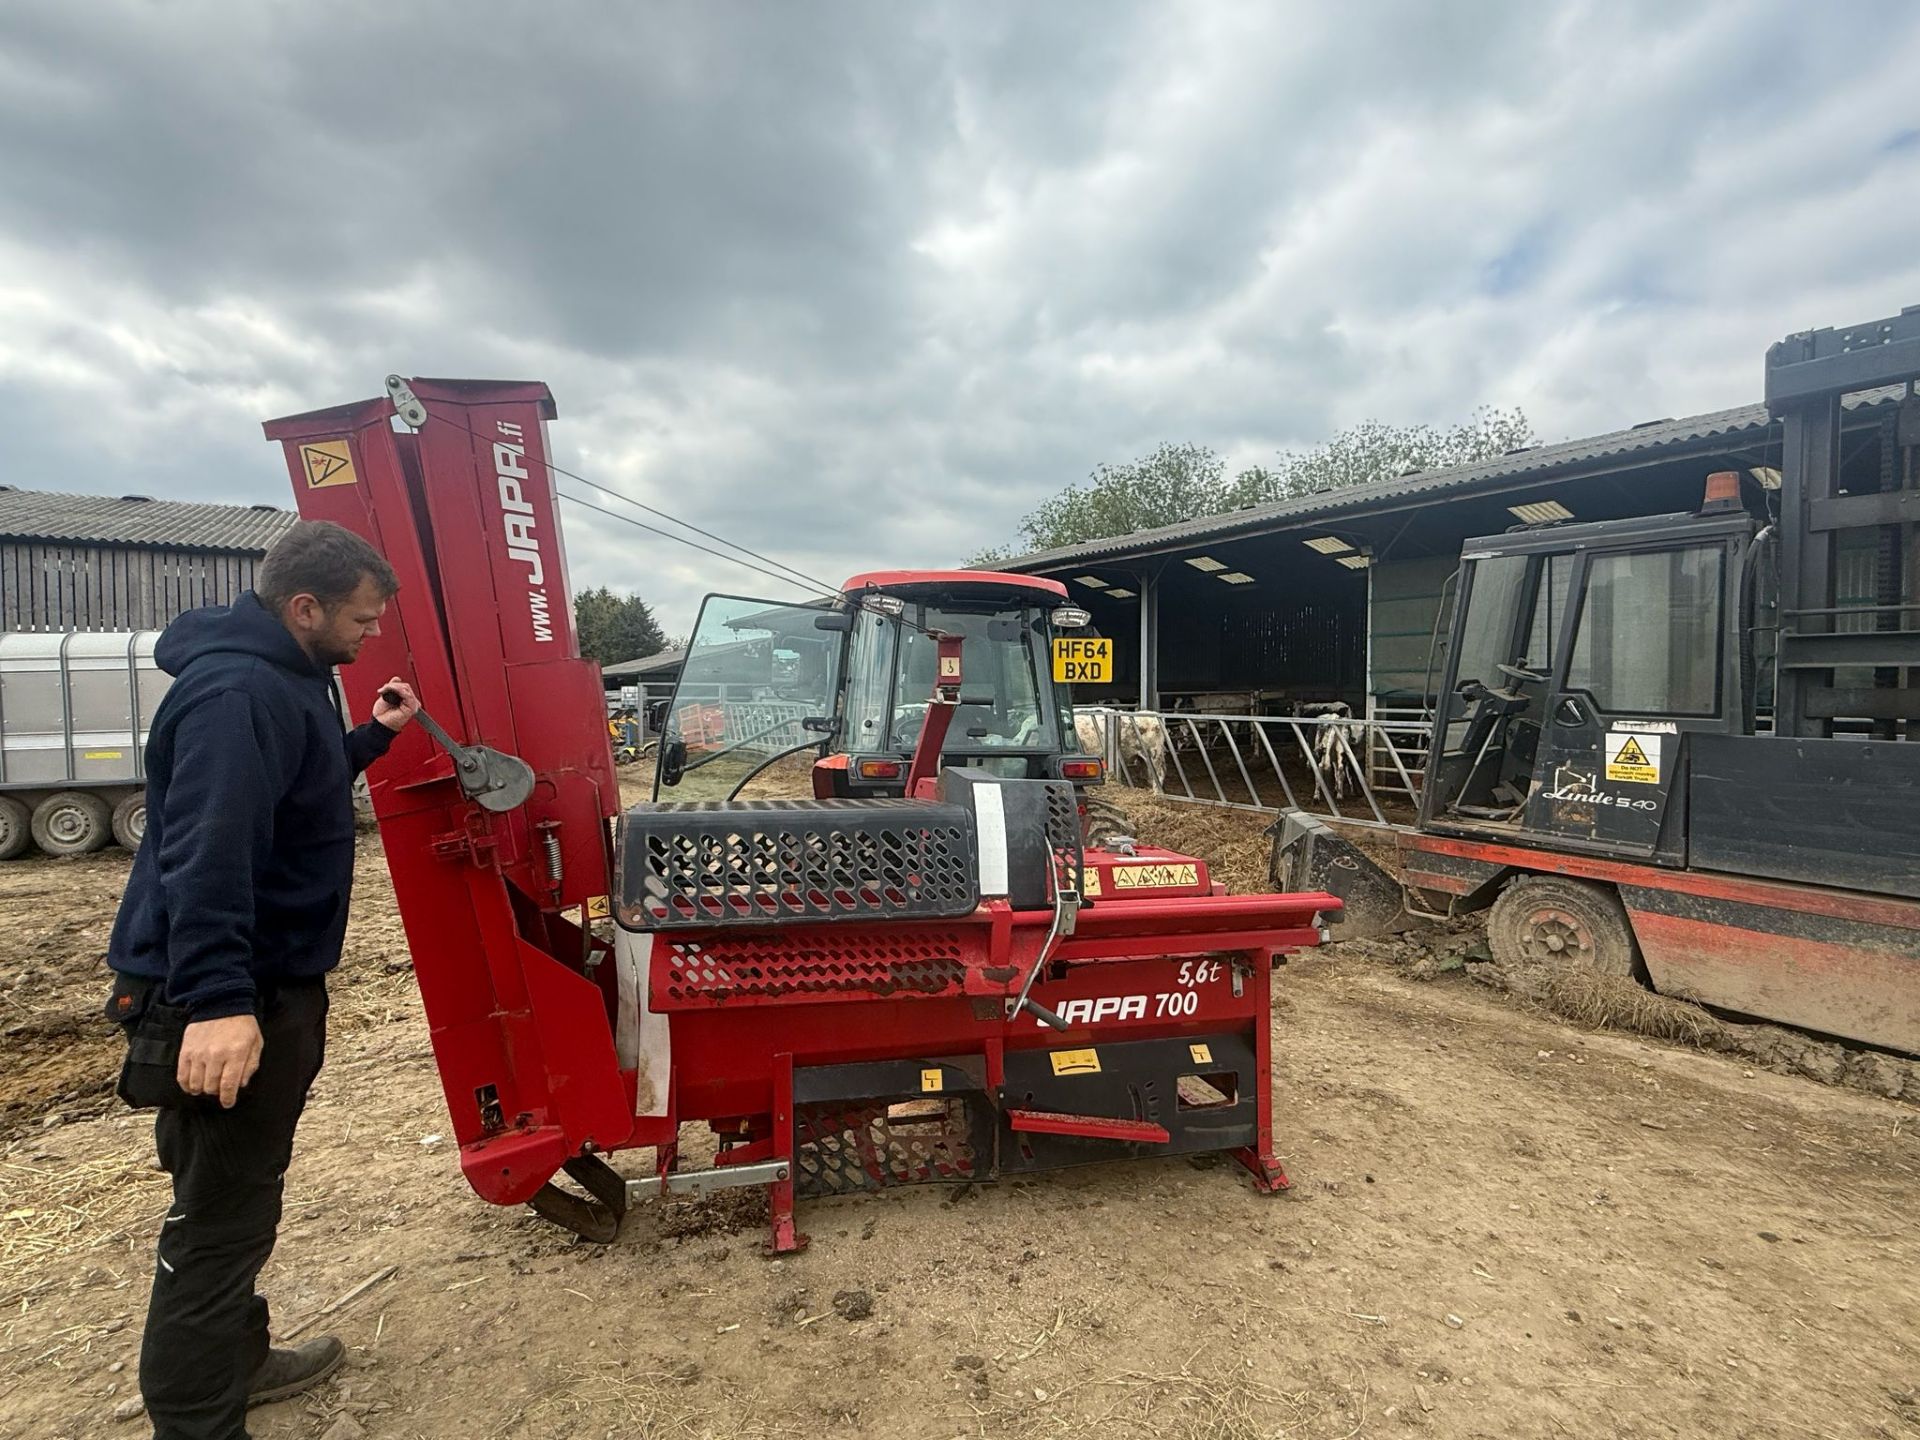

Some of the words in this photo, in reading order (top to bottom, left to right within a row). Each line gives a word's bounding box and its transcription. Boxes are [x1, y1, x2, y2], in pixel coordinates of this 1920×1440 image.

[493, 420, 553, 642] www.JAPA.fi
[1058, 641, 1108, 659] HF64
[1064, 661, 1102, 680] BXD
[1542, 791, 1613, 805] Linde
[1036, 995, 1148, 1027] JAPA
[1155, 991, 1198, 1017] 700
